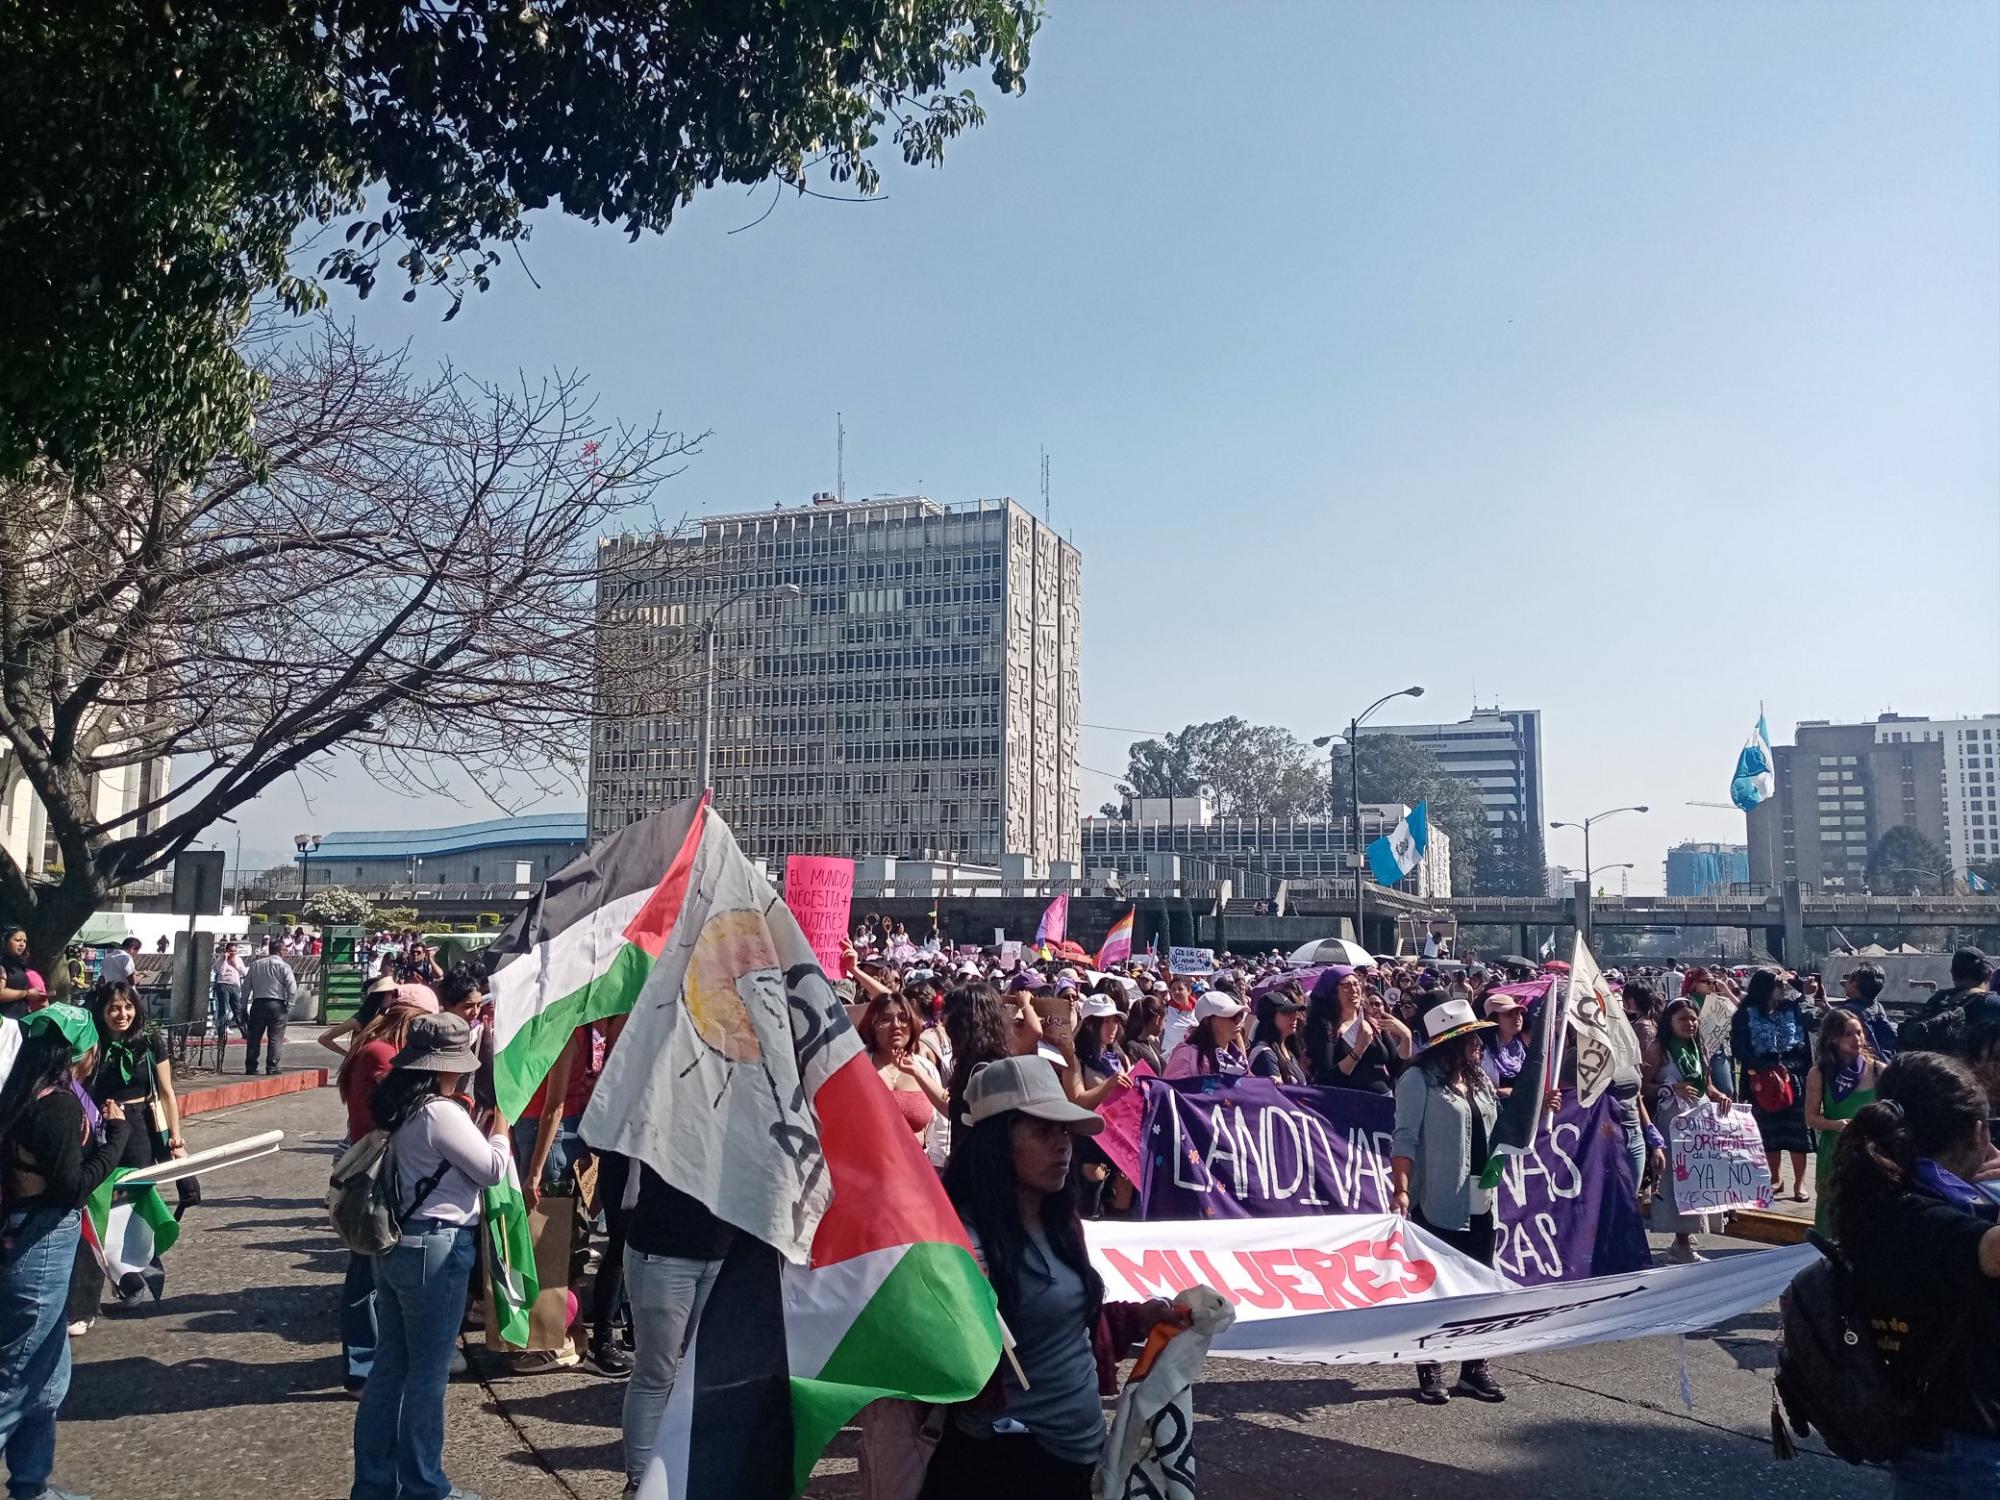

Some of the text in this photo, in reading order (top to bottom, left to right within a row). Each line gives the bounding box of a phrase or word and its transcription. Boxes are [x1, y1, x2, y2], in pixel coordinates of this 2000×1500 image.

[790, 868, 849, 888] EL MUNDO
[788, 889, 840, 908] NECESITA
[1688, 1163, 1752, 1189] YA NO
[1100, 1230, 1437, 1310] MUJERES
